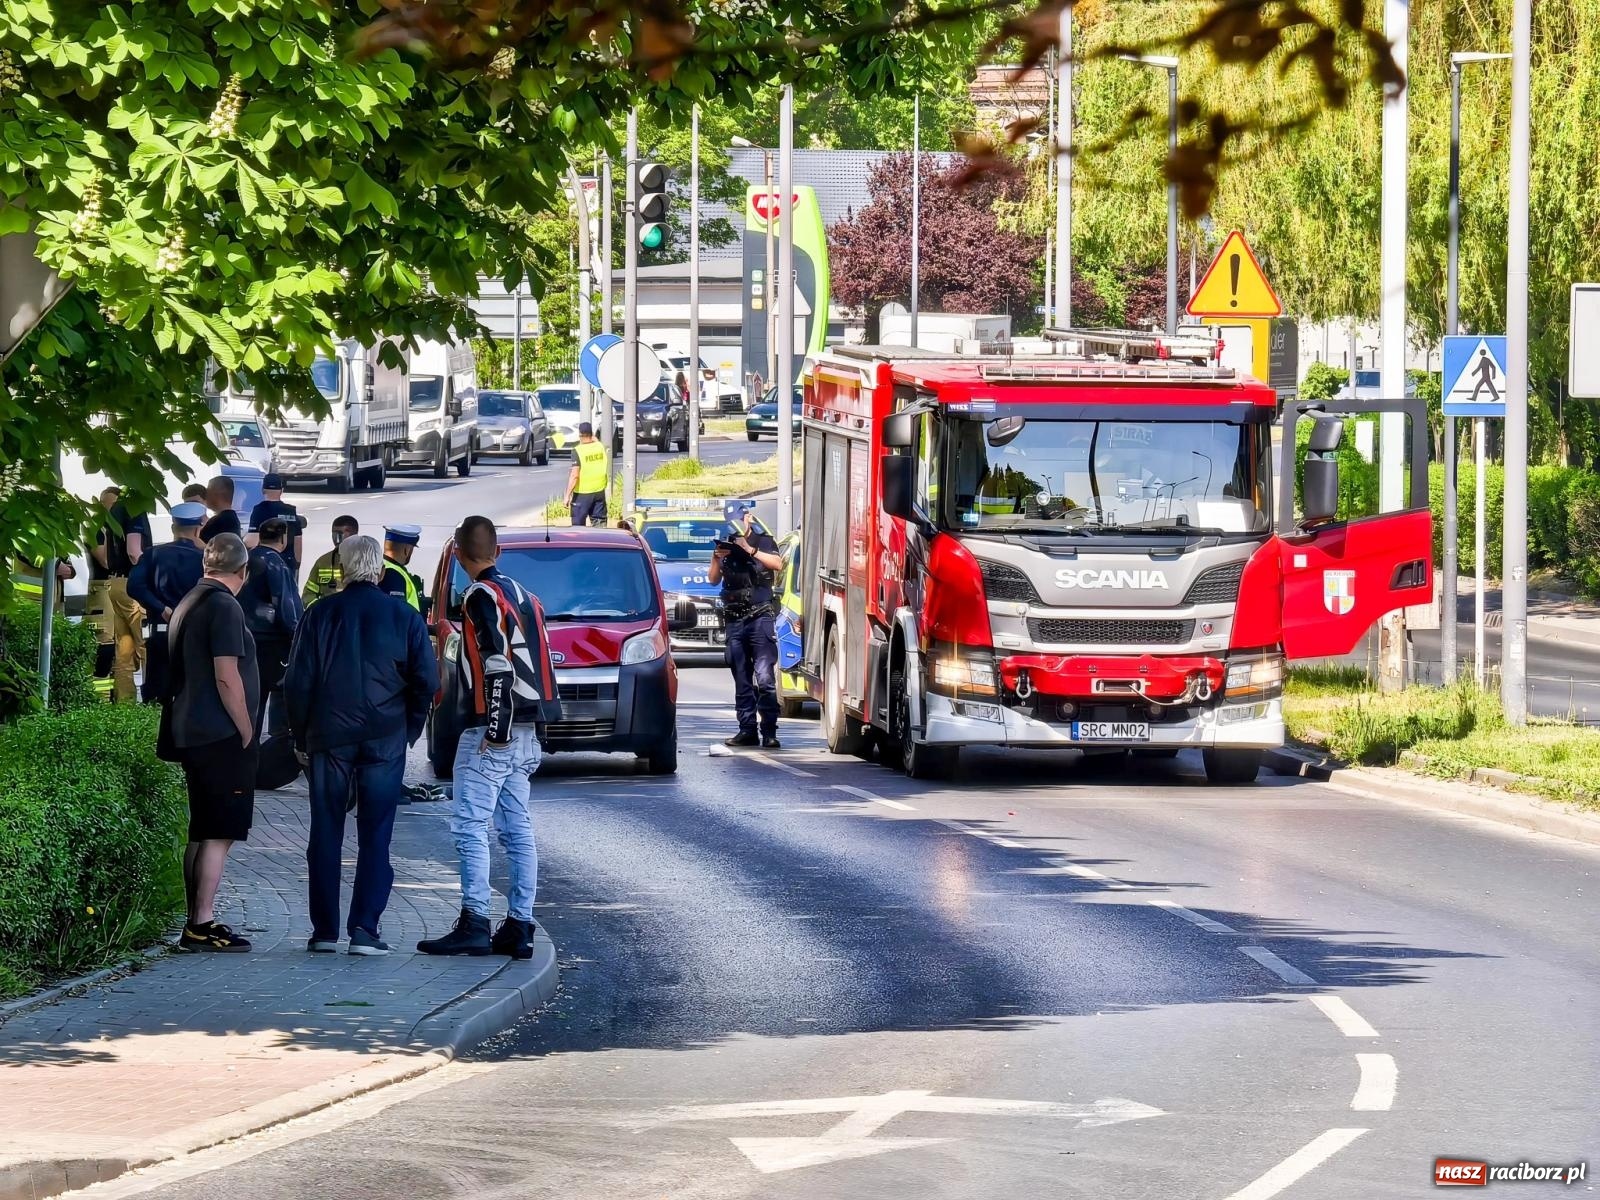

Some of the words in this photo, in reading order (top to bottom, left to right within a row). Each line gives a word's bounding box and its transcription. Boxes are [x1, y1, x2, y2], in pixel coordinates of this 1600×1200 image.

[1054, 569, 1169, 589] SCANIA
[488, 678, 504, 739] SLAYER
[1081, 723, 1107, 737] SRC
[1112, 723, 1145, 737] MN02
